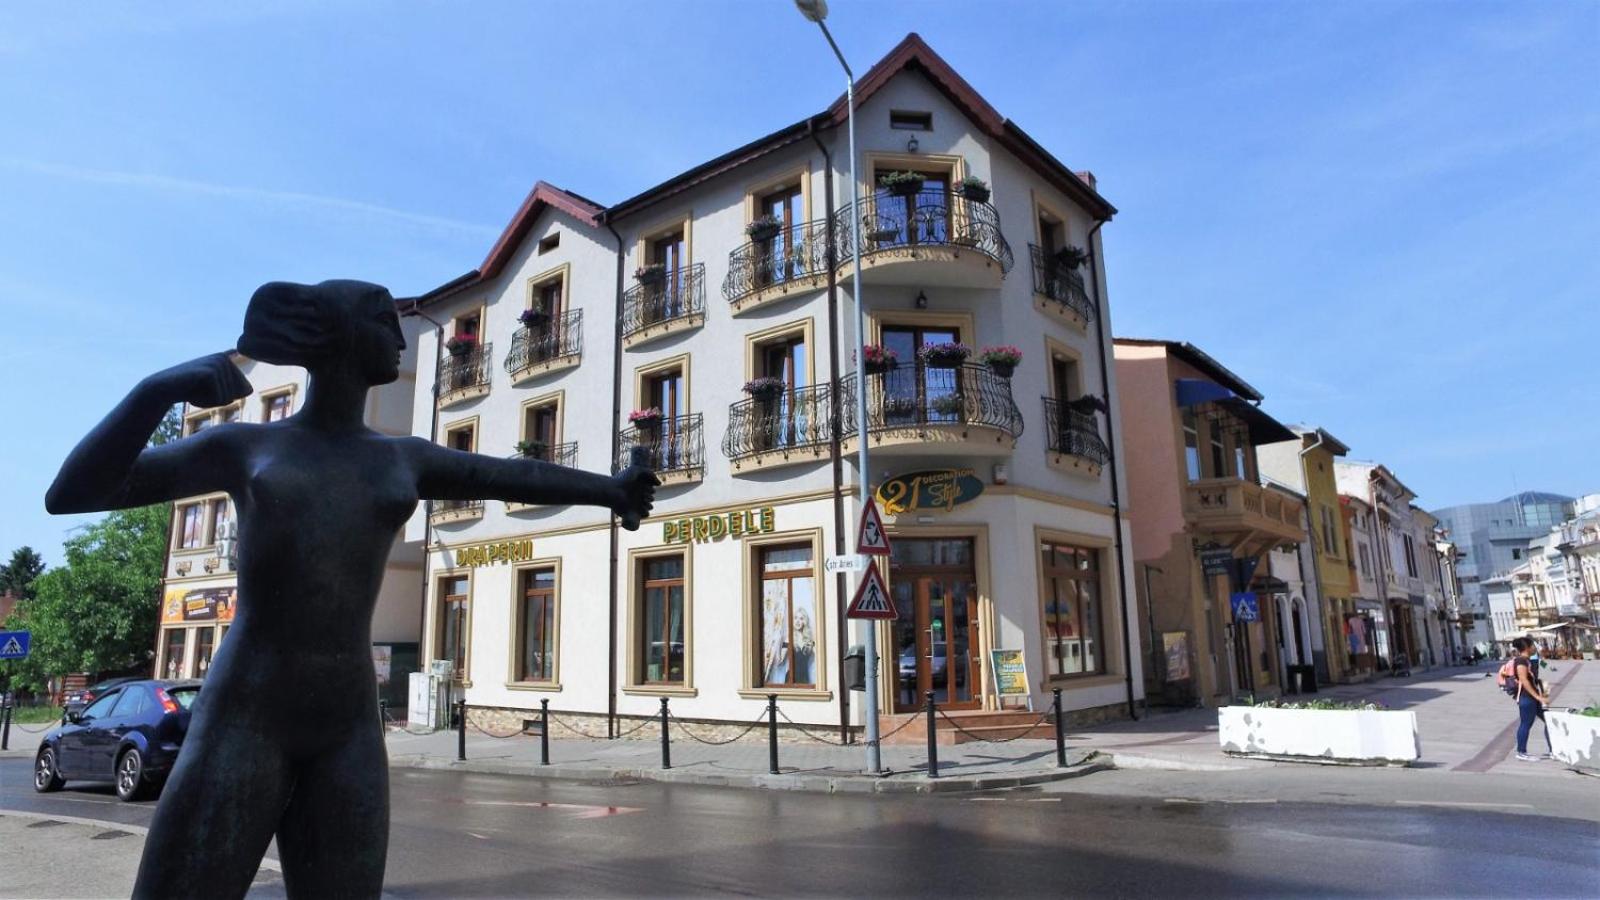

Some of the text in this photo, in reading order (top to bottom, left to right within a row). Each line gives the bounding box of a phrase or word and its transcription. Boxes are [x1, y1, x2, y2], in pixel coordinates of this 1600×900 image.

[876, 476, 922, 515] 21
[927, 480, 964, 512] Style
[662, 505, 776, 543] PERDELE
[456, 541, 534, 567] DRAPERII
